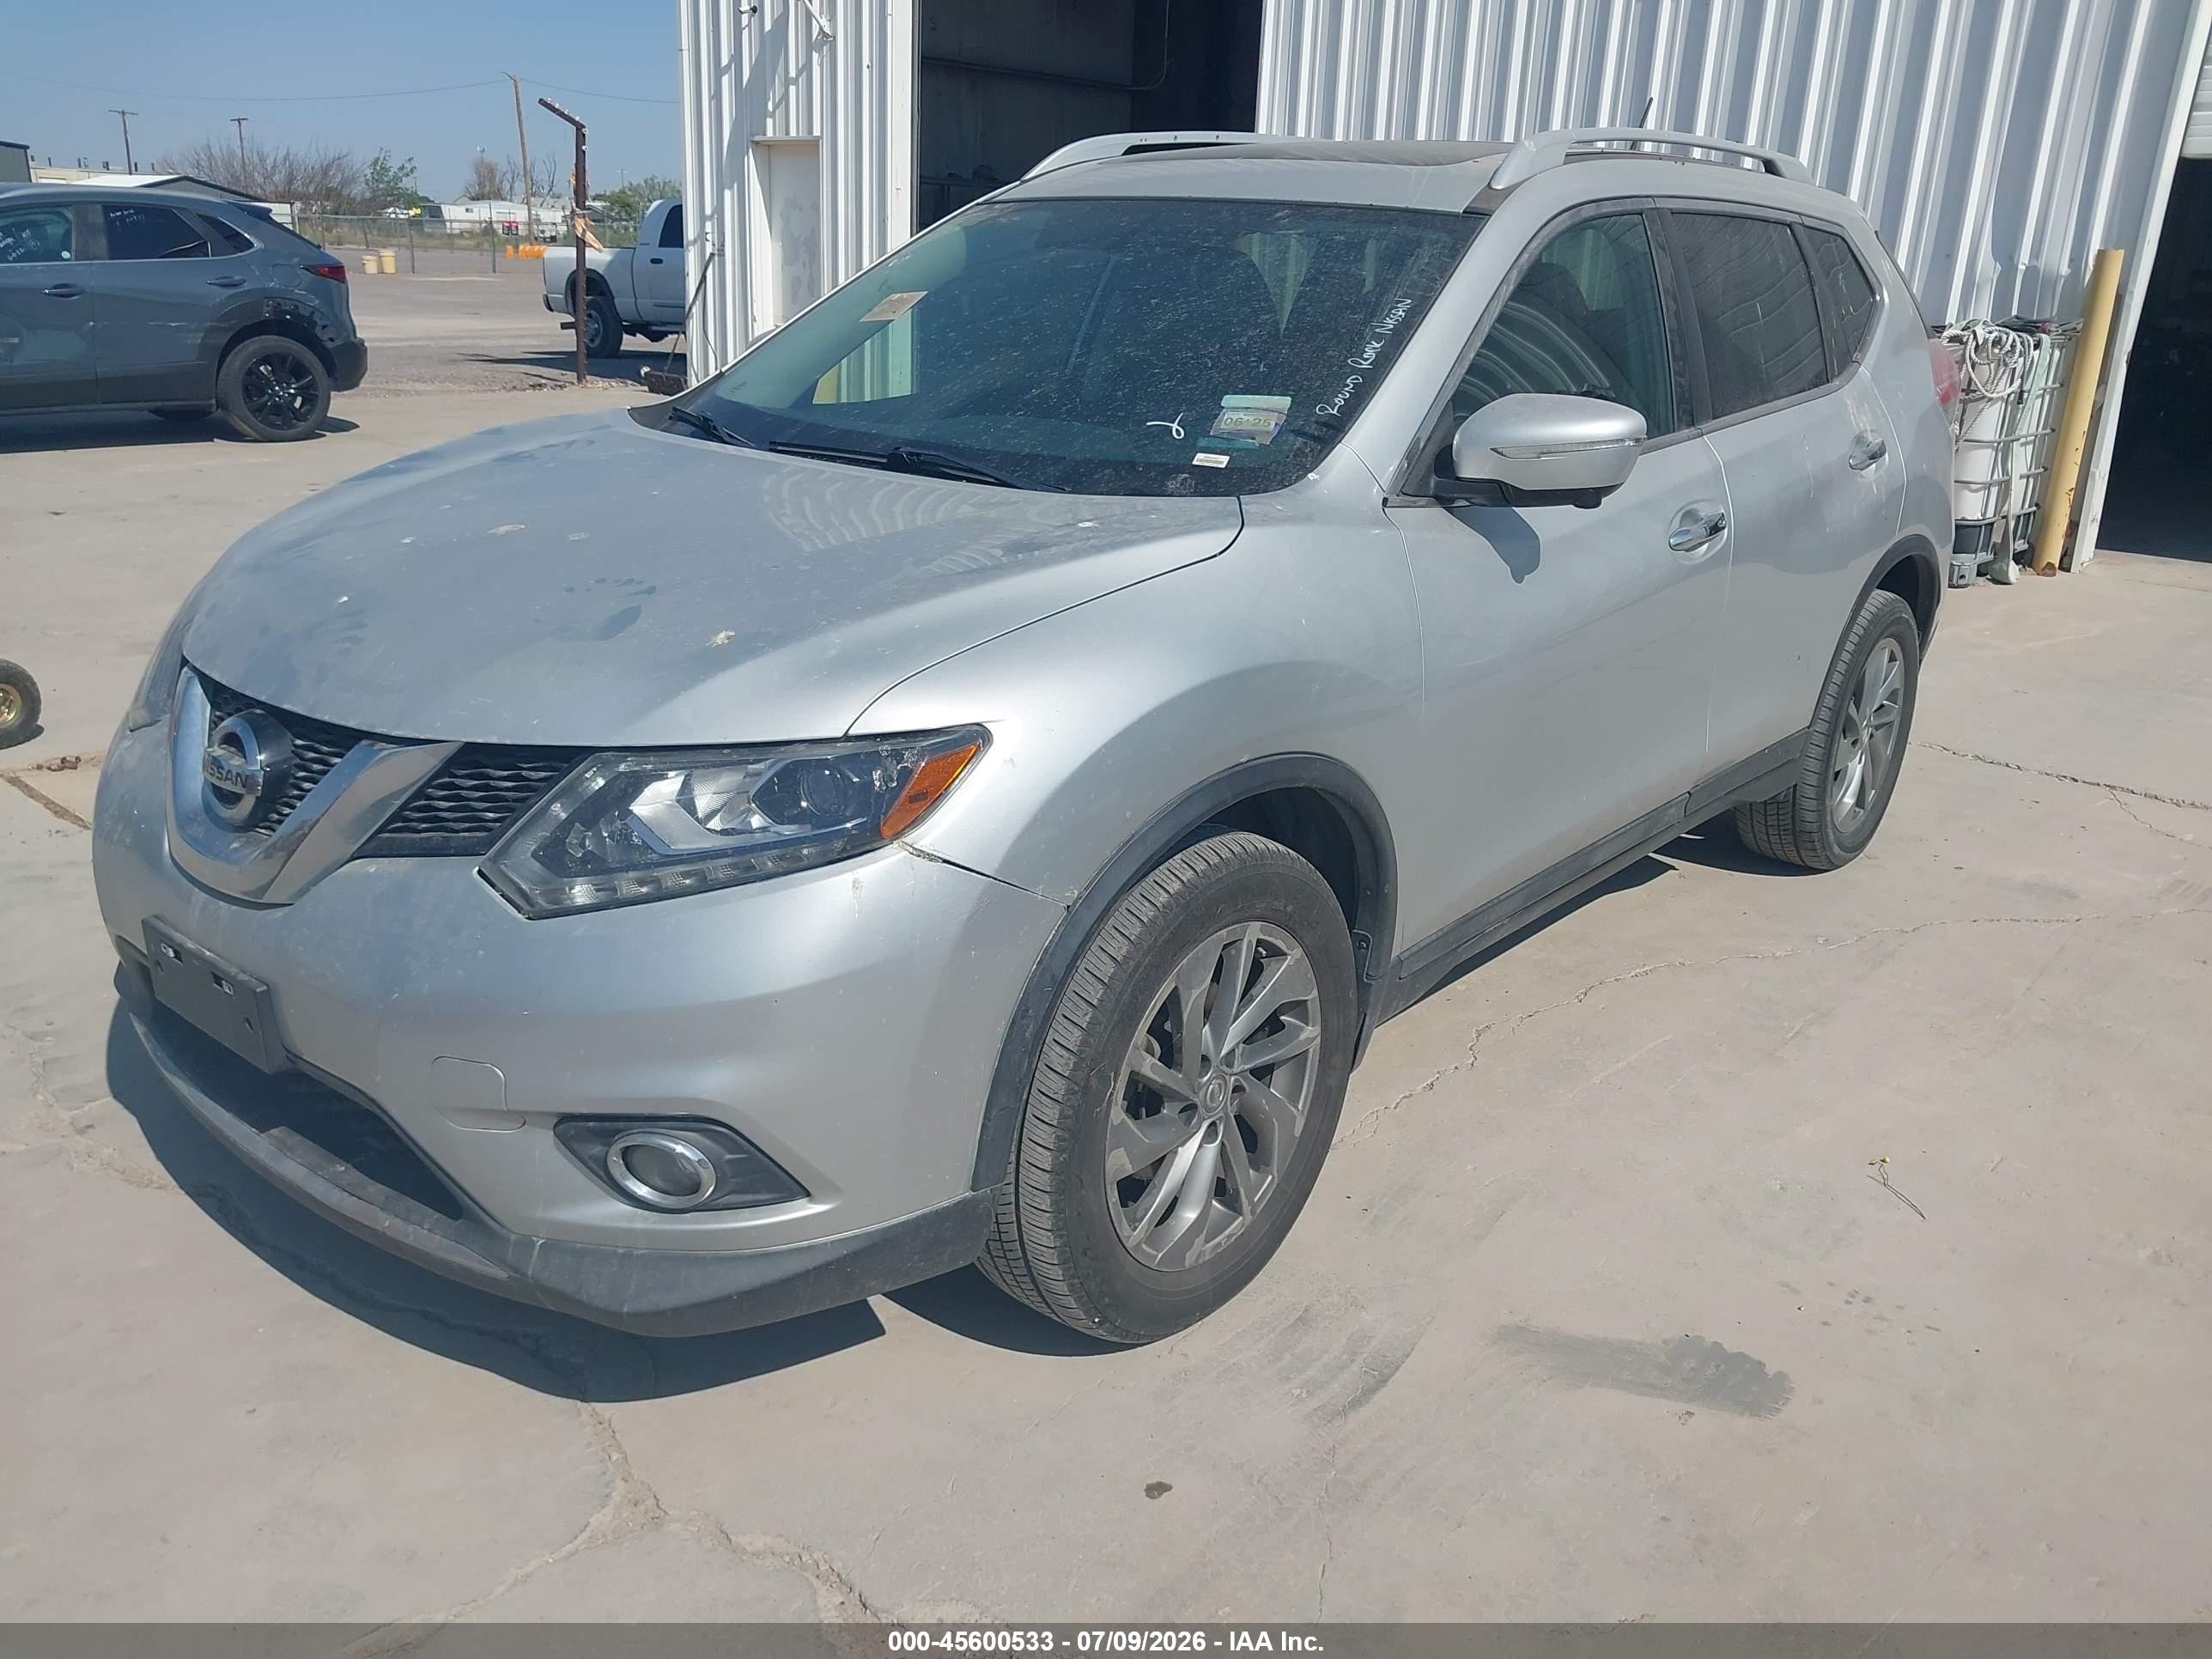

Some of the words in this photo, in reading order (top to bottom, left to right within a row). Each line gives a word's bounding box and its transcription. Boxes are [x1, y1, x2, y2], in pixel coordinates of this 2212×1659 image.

[1316, 374, 1364, 417] ROUND
[1347, 338, 1385, 368] ROCK
[206, 756, 247, 788] NISSAN
